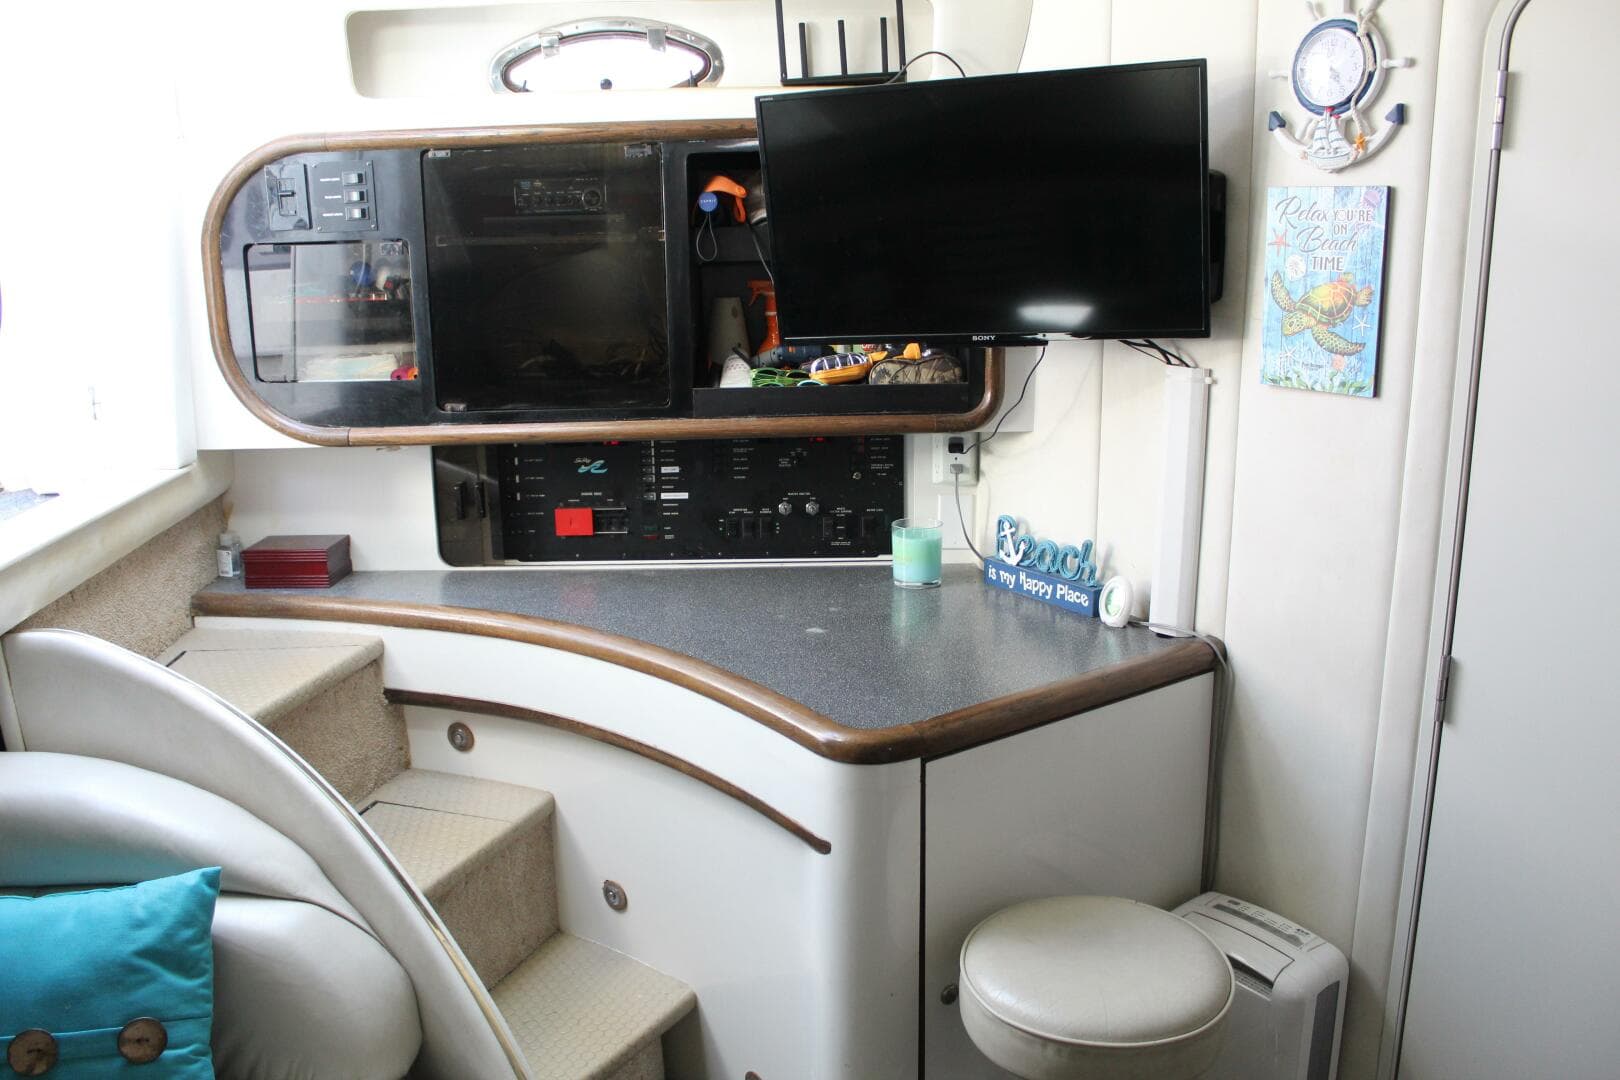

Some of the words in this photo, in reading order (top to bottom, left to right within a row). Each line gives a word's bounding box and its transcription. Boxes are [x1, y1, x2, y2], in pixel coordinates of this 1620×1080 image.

[1275, 195, 1328, 229] Relax
[1333, 209, 1372, 222] YOU'RE
[1296, 225, 1358, 253] Beach
[1333, 223, 1348, 236] ON
[1312, 256, 1345, 272] TIME
[995, 514, 1098, 587] Beach
[988, 565, 997, 580] is
[999, 569, 1016, 589] my
[1019, 571, 1053, 599] Happy
[1055, 583, 1089, 607] Place
